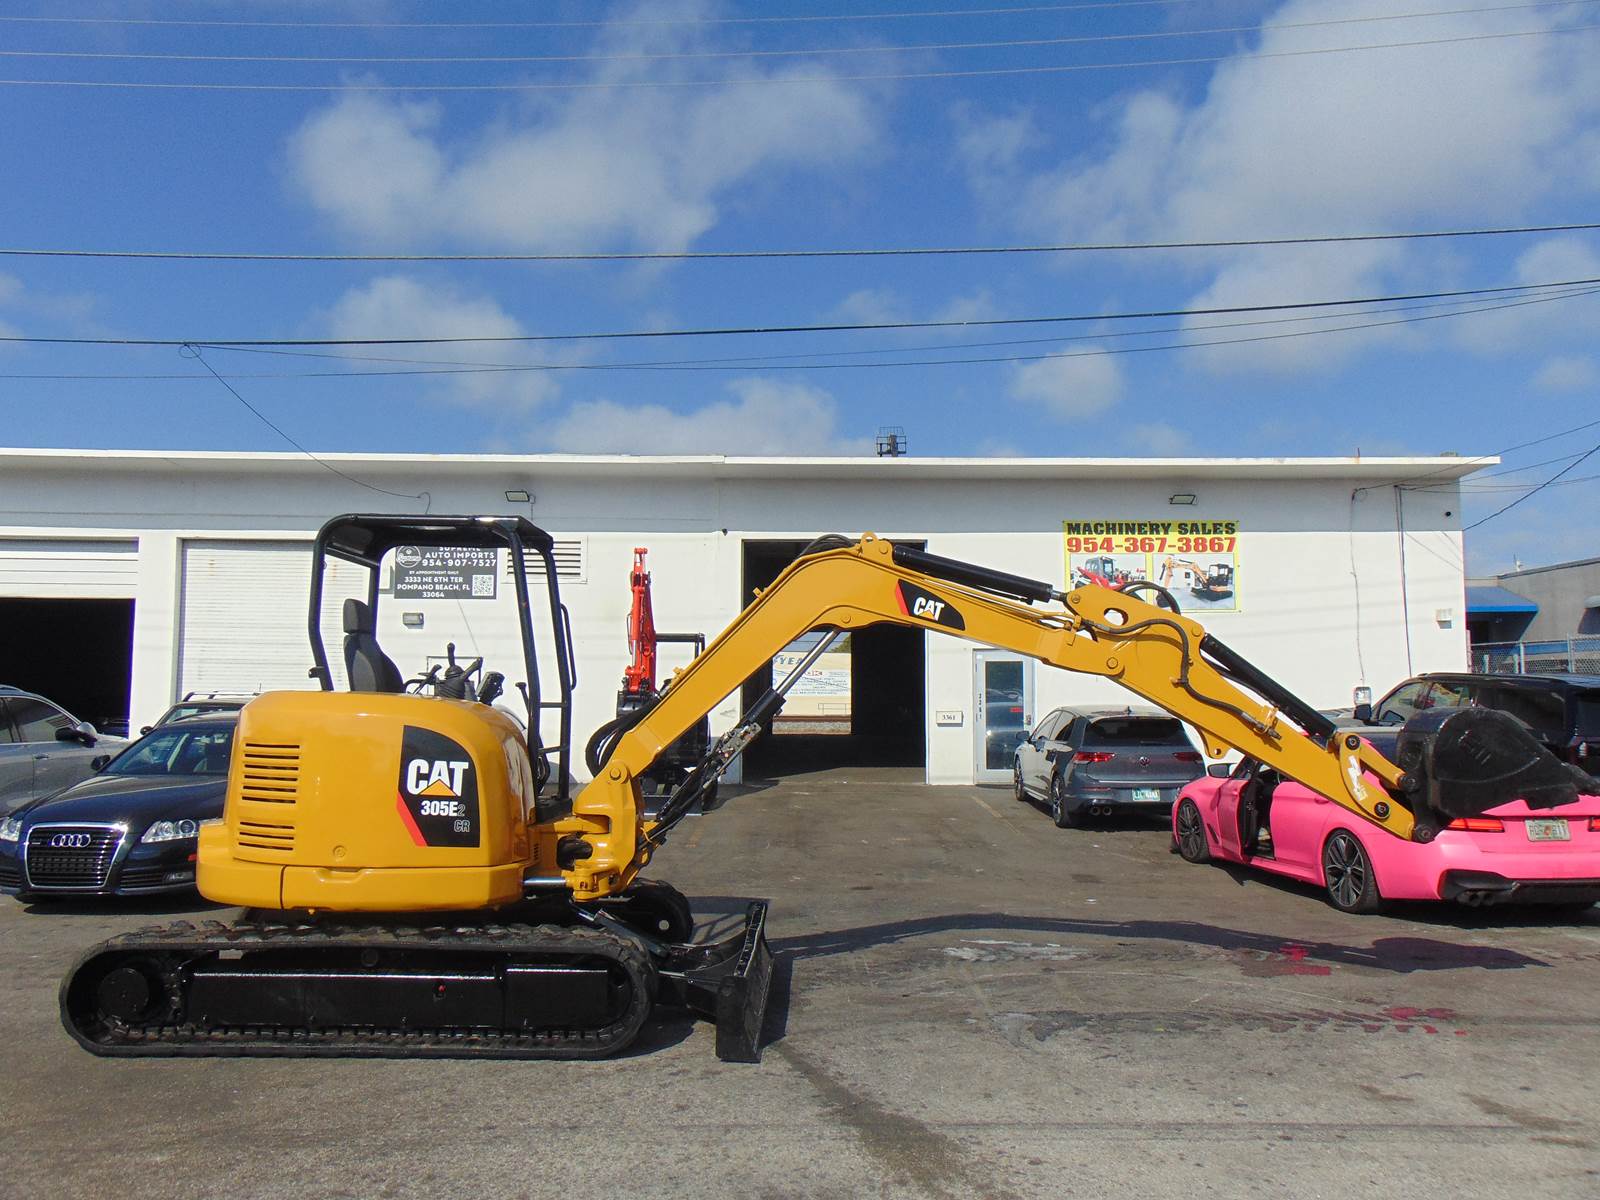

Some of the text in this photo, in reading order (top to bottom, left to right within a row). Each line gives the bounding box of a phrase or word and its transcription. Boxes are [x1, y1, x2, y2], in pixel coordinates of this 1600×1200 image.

[1066, 522, 1236, 535] MACHINERY SALES
[1066, 537, 1236, 553] 954-367-3867
[422, 559, 497, 567] 954-907-7527
[435, 584, 461, 592] BEACH,
[913, 596, 945, 621] CAT
[406, 759, 469, 797] CAT
[421, 800, 466, 817] 305E2
[453, 819, 470, 833] CR
